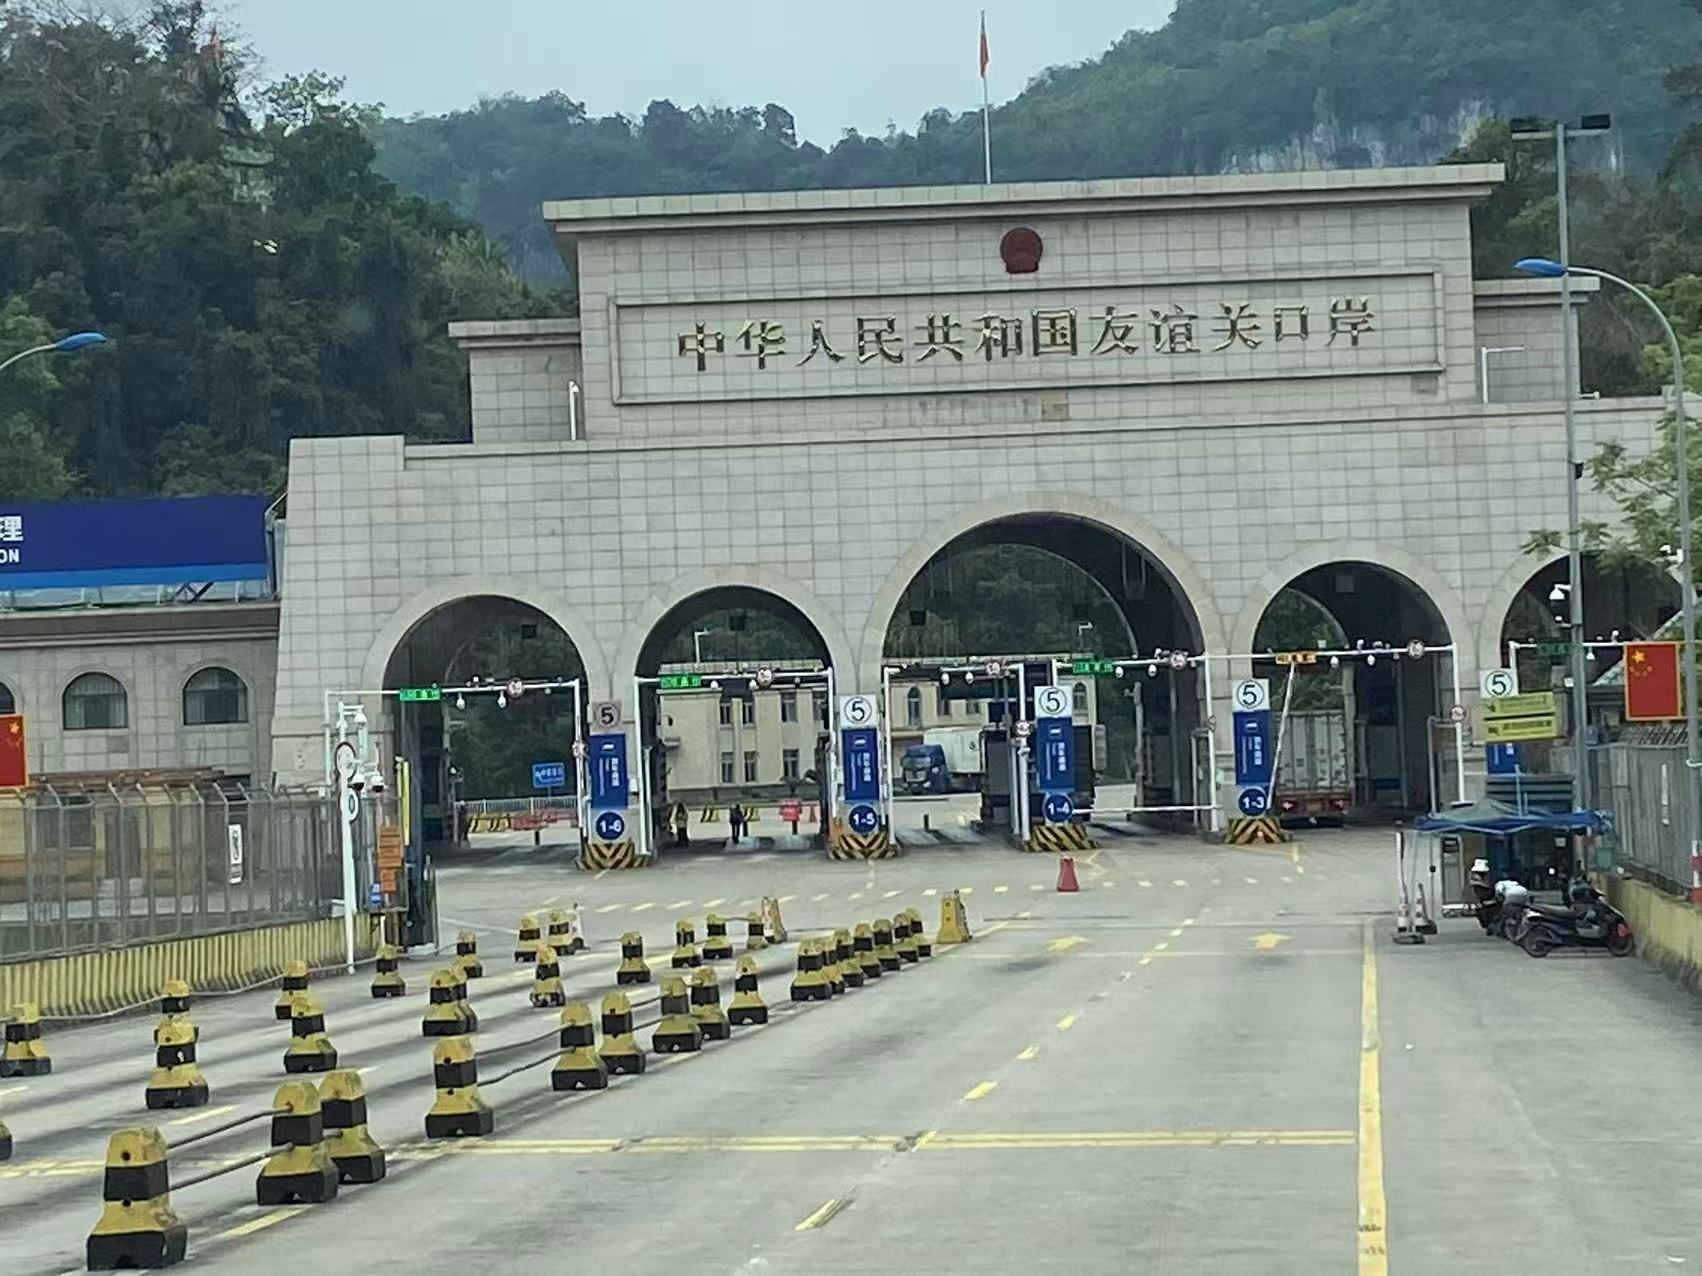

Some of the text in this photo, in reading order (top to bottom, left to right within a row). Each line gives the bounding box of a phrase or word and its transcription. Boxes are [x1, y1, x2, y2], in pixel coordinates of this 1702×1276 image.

[678, 297, 1377, 371] 中华人民共和国友谊关口岸
[1241, 684, 1257, 706] 5
[1492, 675, 1507, 696] 5
[851, 700, 866, 721] 5
[1046, 689, 1061, 712] 5
[601, 706, 615, 726] 5
